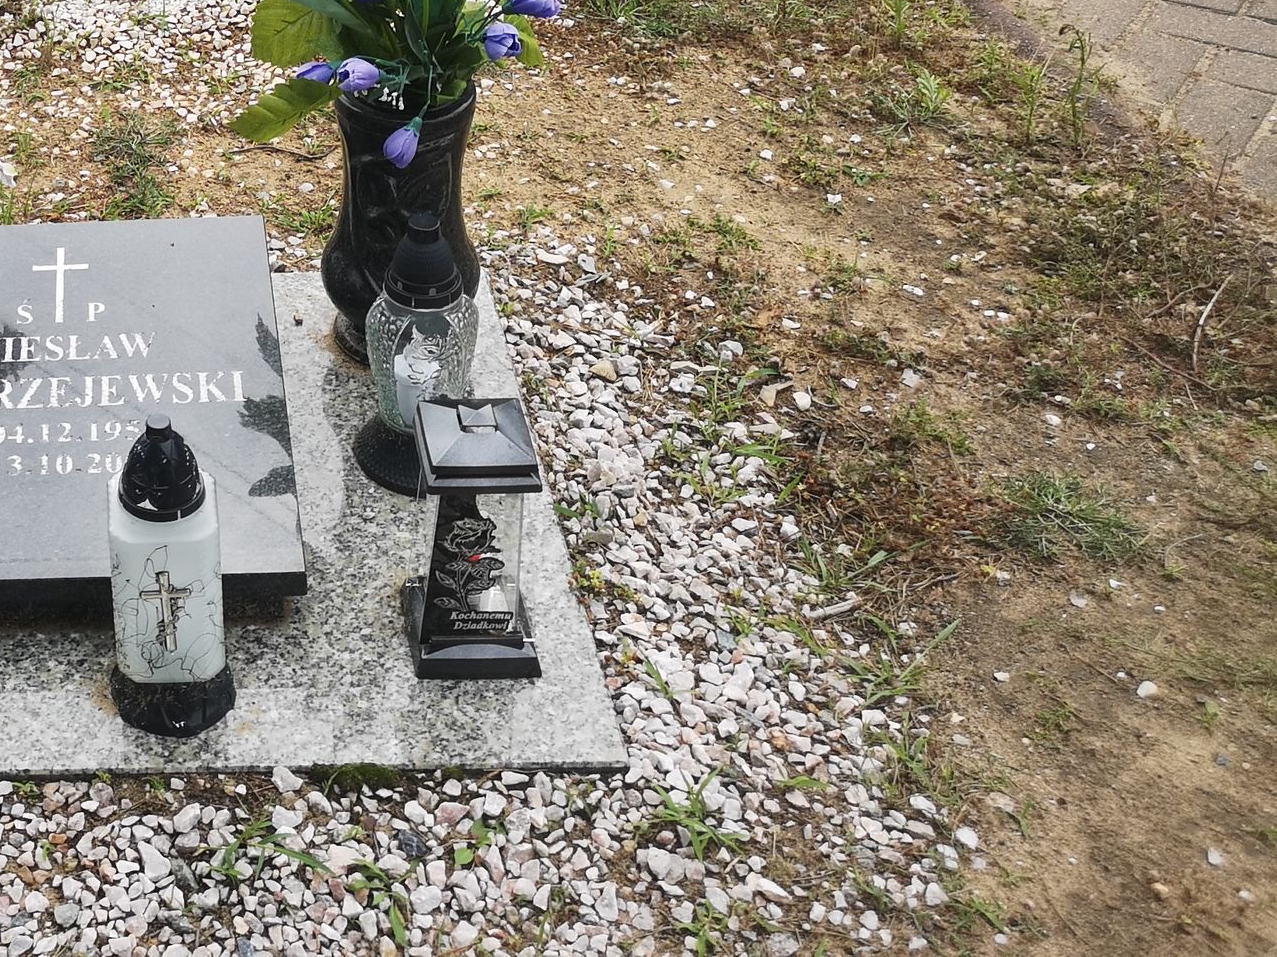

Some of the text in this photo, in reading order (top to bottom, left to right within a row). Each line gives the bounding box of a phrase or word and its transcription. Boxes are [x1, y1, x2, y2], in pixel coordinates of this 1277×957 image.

[17, 299, 106, 324] Ś P
[449, 611, 512, 620] Kochanemu
